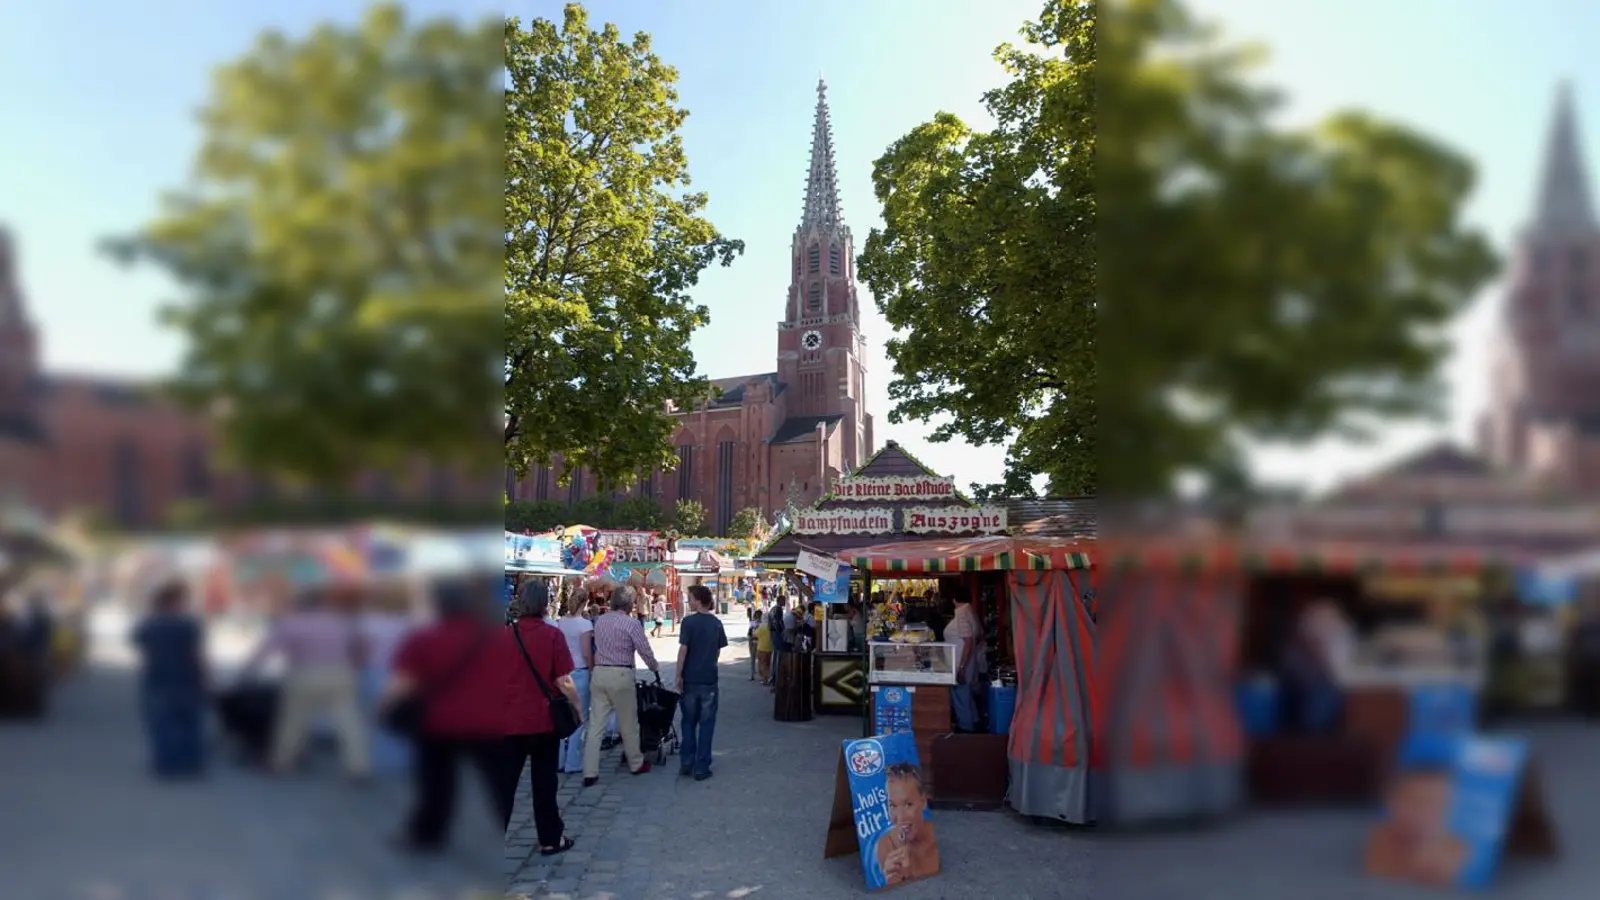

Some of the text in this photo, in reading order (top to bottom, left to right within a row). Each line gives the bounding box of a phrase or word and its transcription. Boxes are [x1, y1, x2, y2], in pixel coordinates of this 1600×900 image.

[833, 483, 853, 497] Die
[797, 515, 889, 532] Dampfnudeln
[857, 803, 892, 839] dir!
